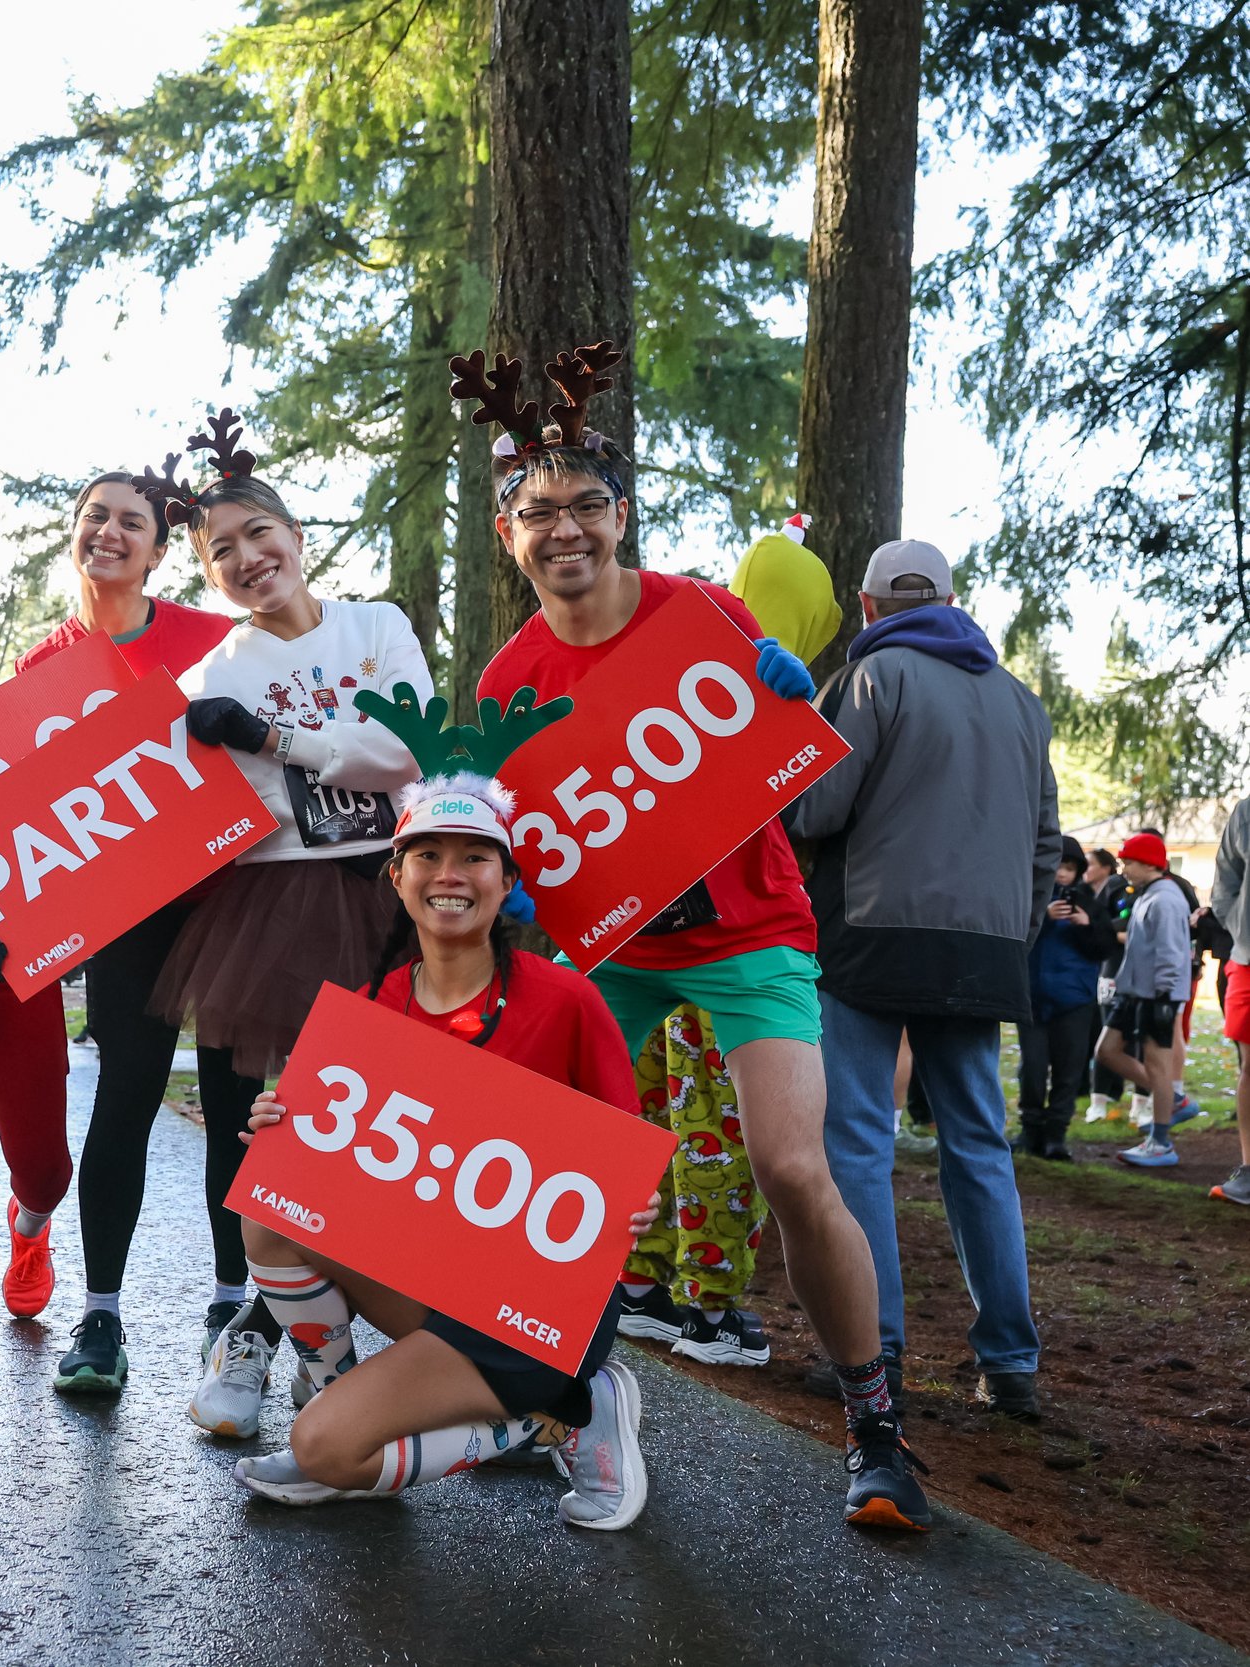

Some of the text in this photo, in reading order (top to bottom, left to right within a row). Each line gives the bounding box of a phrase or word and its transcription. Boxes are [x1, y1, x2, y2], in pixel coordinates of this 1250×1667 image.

[512, 660, 756, 887] 35:00
[766, 744, 823, 792] PACER
[205, 817, 256, 856] PACER
[579, 895, 643, 950] KAMINO
[24, 933, 86, 978] KAMINO
[292, 1064, 606, 1263] 35:00
[250, 1183, 327, 1235] KAMINO
[496, 1303, 562, 1349] PACER
[715, 1328, 742, 1348] HOKA
